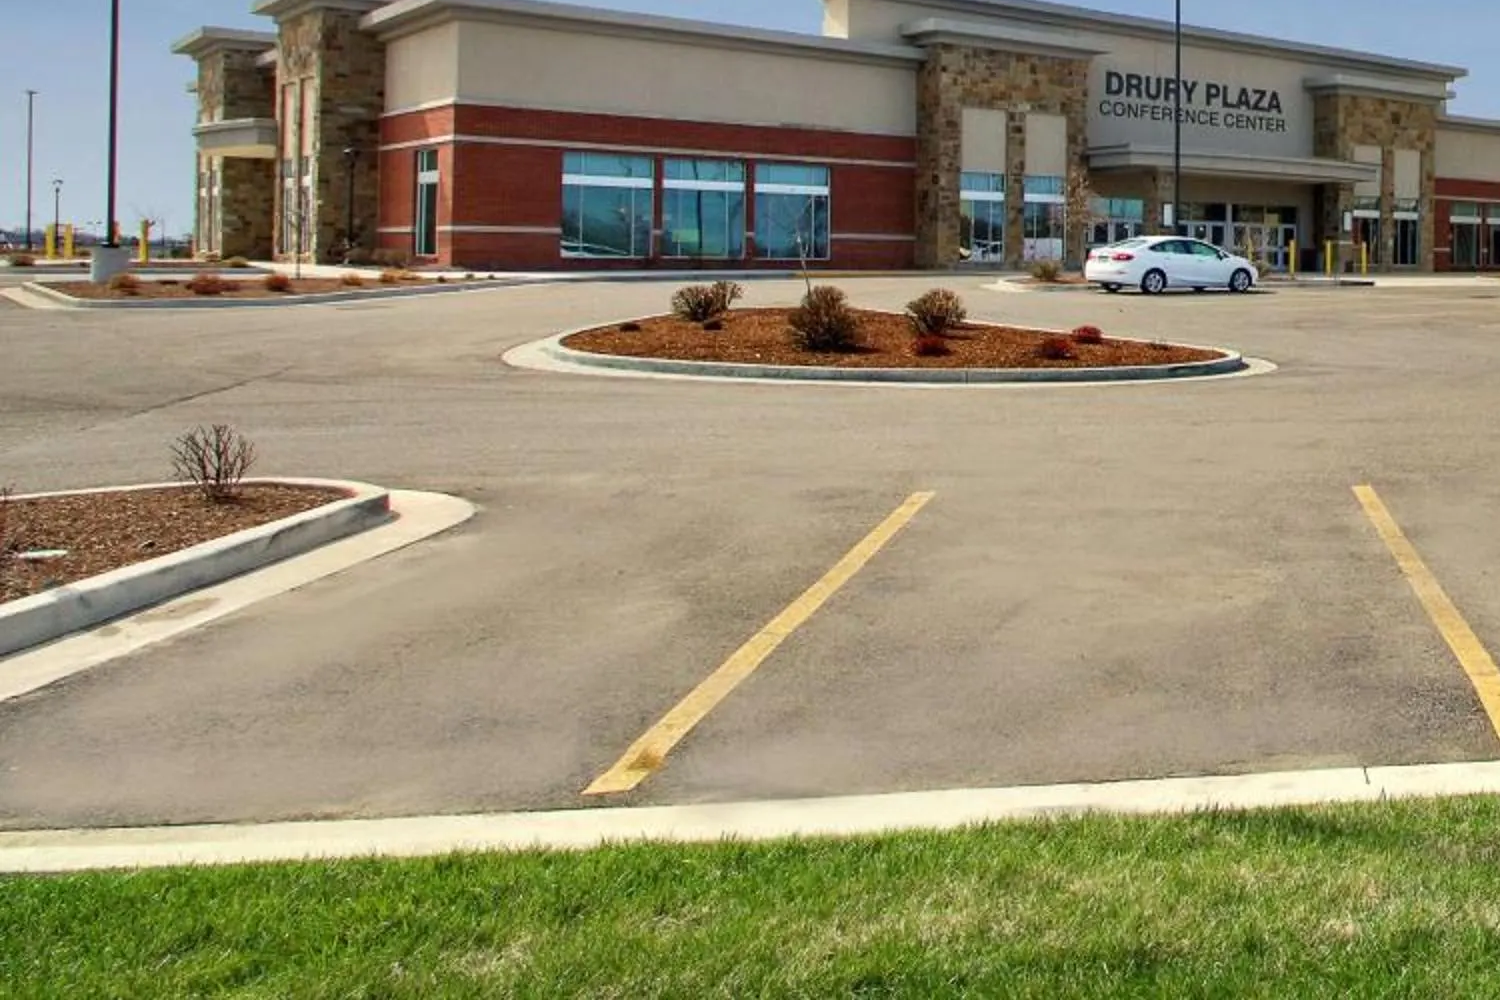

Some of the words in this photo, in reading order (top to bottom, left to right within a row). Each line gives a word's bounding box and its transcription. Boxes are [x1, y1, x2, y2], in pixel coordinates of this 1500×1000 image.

[1105, 71, 1198, 104] DRURY
[1205, 82, 1282, 114] PLAZA
[1099, 100, 1220, 127] CONFERENCE
[1223, 112, 1286, 132] CENTER
